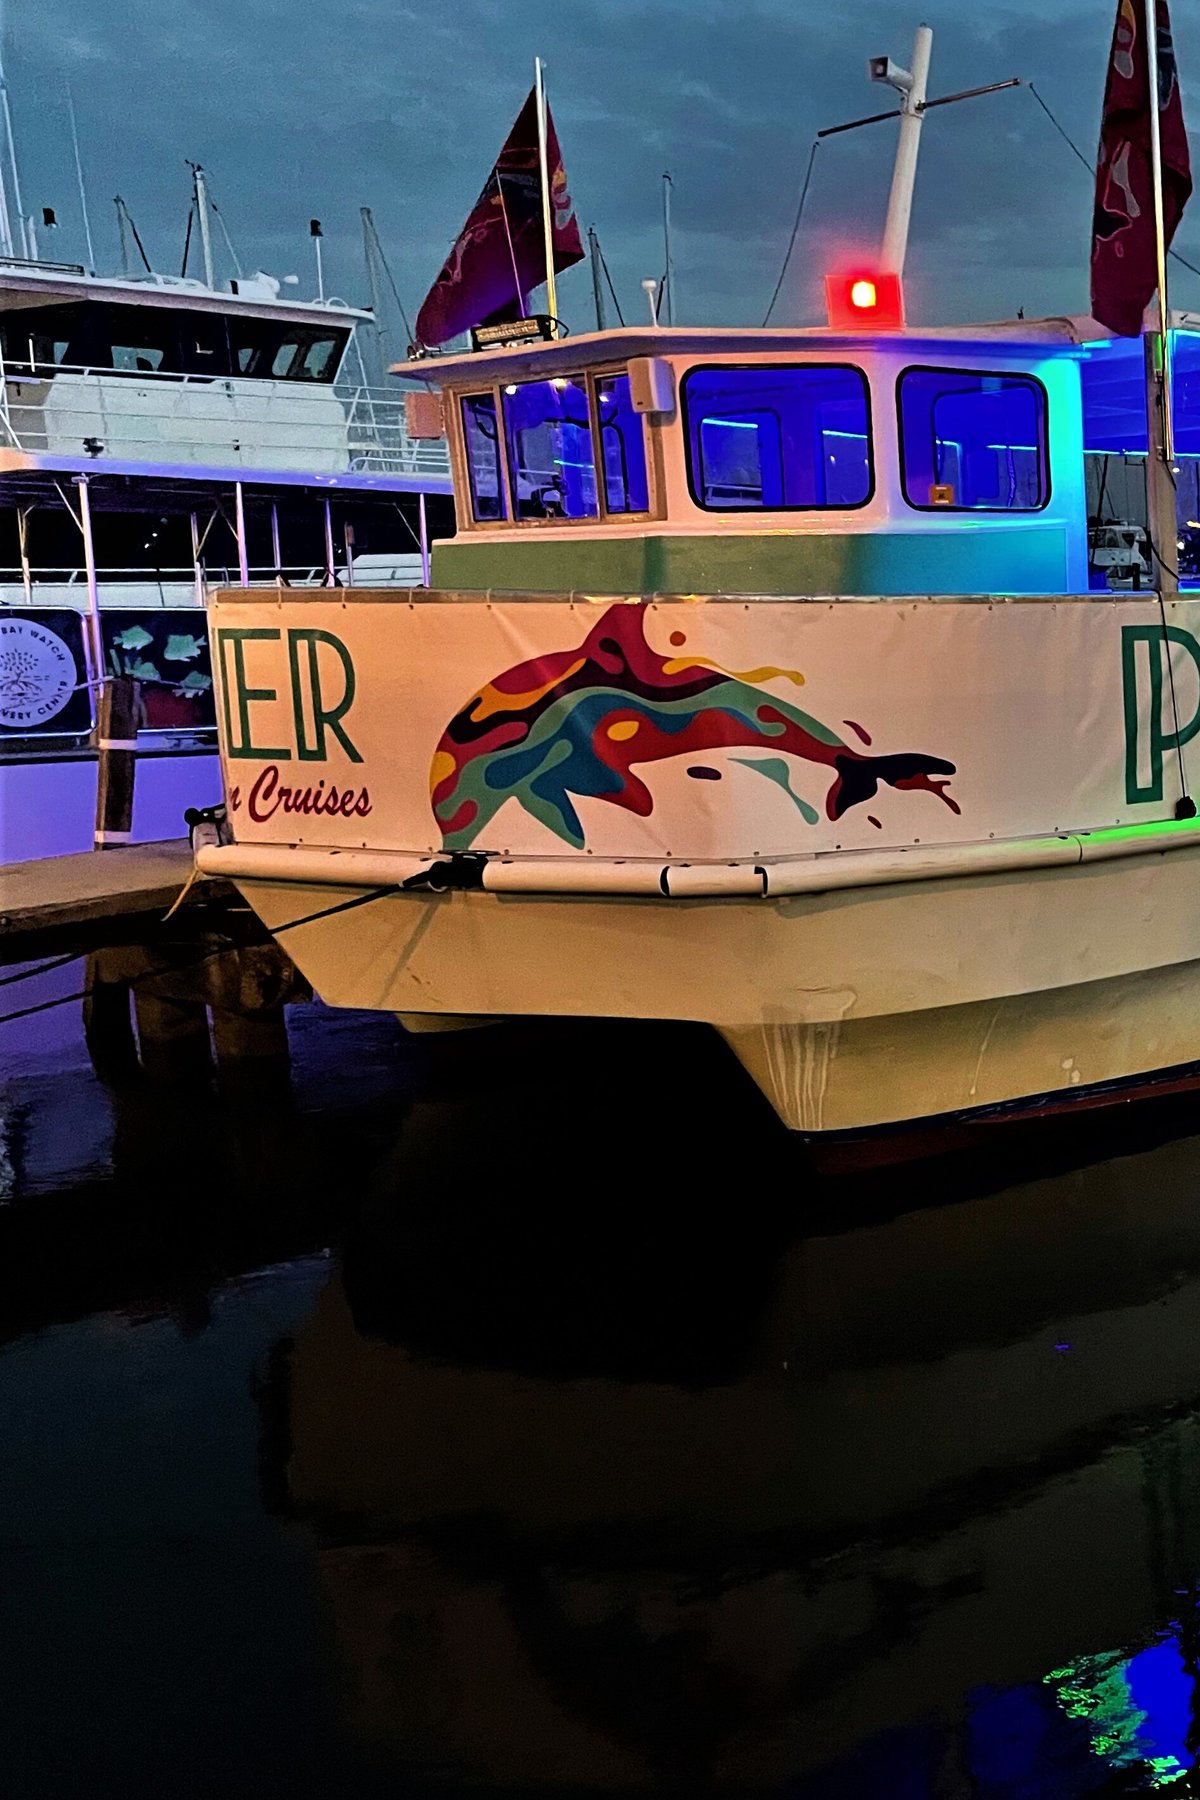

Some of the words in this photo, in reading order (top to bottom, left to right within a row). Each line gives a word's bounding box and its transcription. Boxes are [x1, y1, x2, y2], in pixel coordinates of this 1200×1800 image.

[1, 626, 23, 634] BAY
[30, 630, 66, 661] WATCH
[248, 765, 373, 823] Cruises
